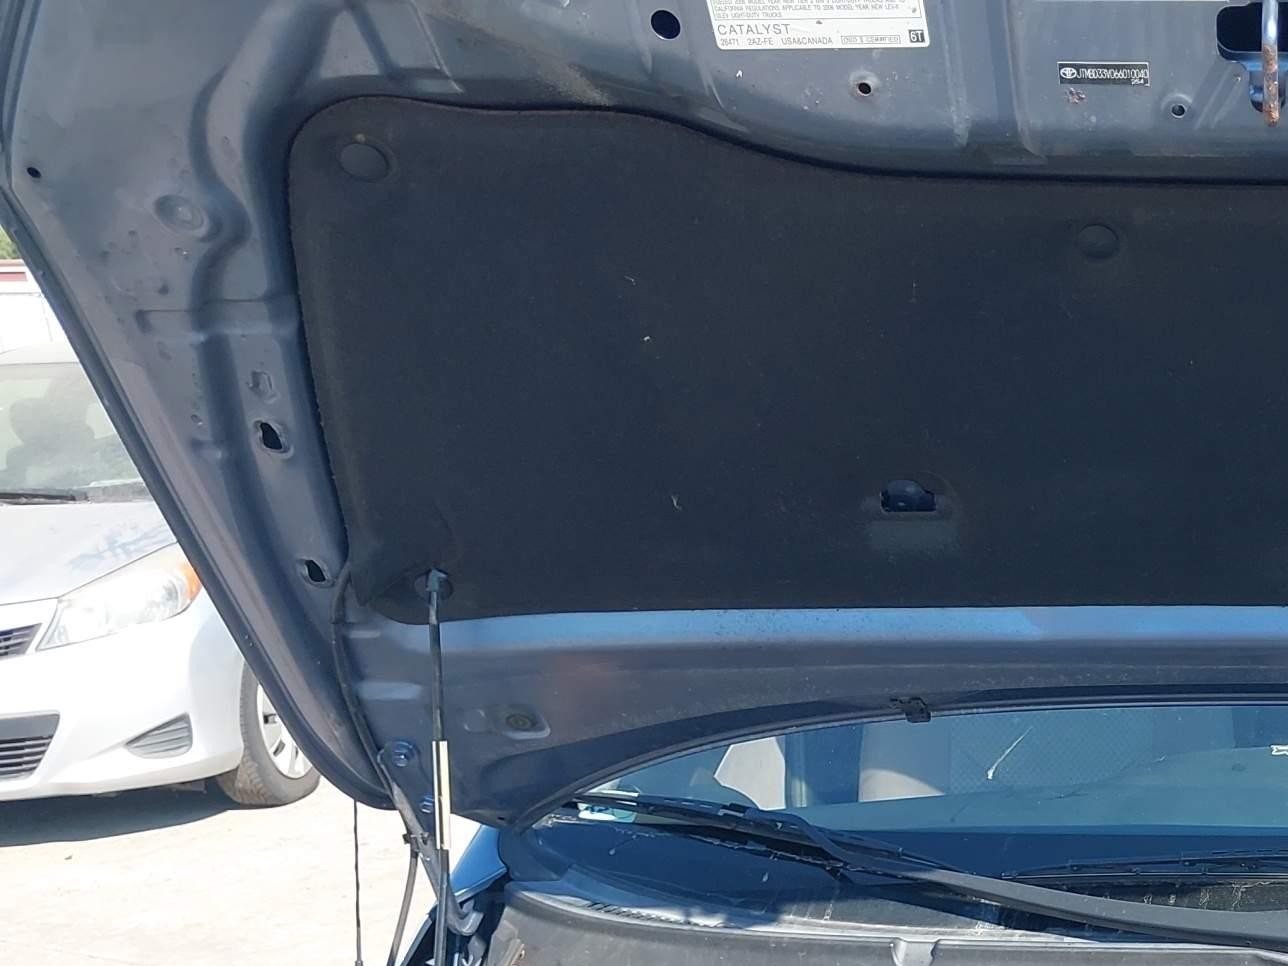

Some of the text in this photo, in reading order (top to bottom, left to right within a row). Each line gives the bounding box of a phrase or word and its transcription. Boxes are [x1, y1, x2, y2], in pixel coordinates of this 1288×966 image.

[717, 23, 791, 36] CATALYST
[781, 37, 834, 45] USA&CANADA
[910, 31, 923, 42] 6T
